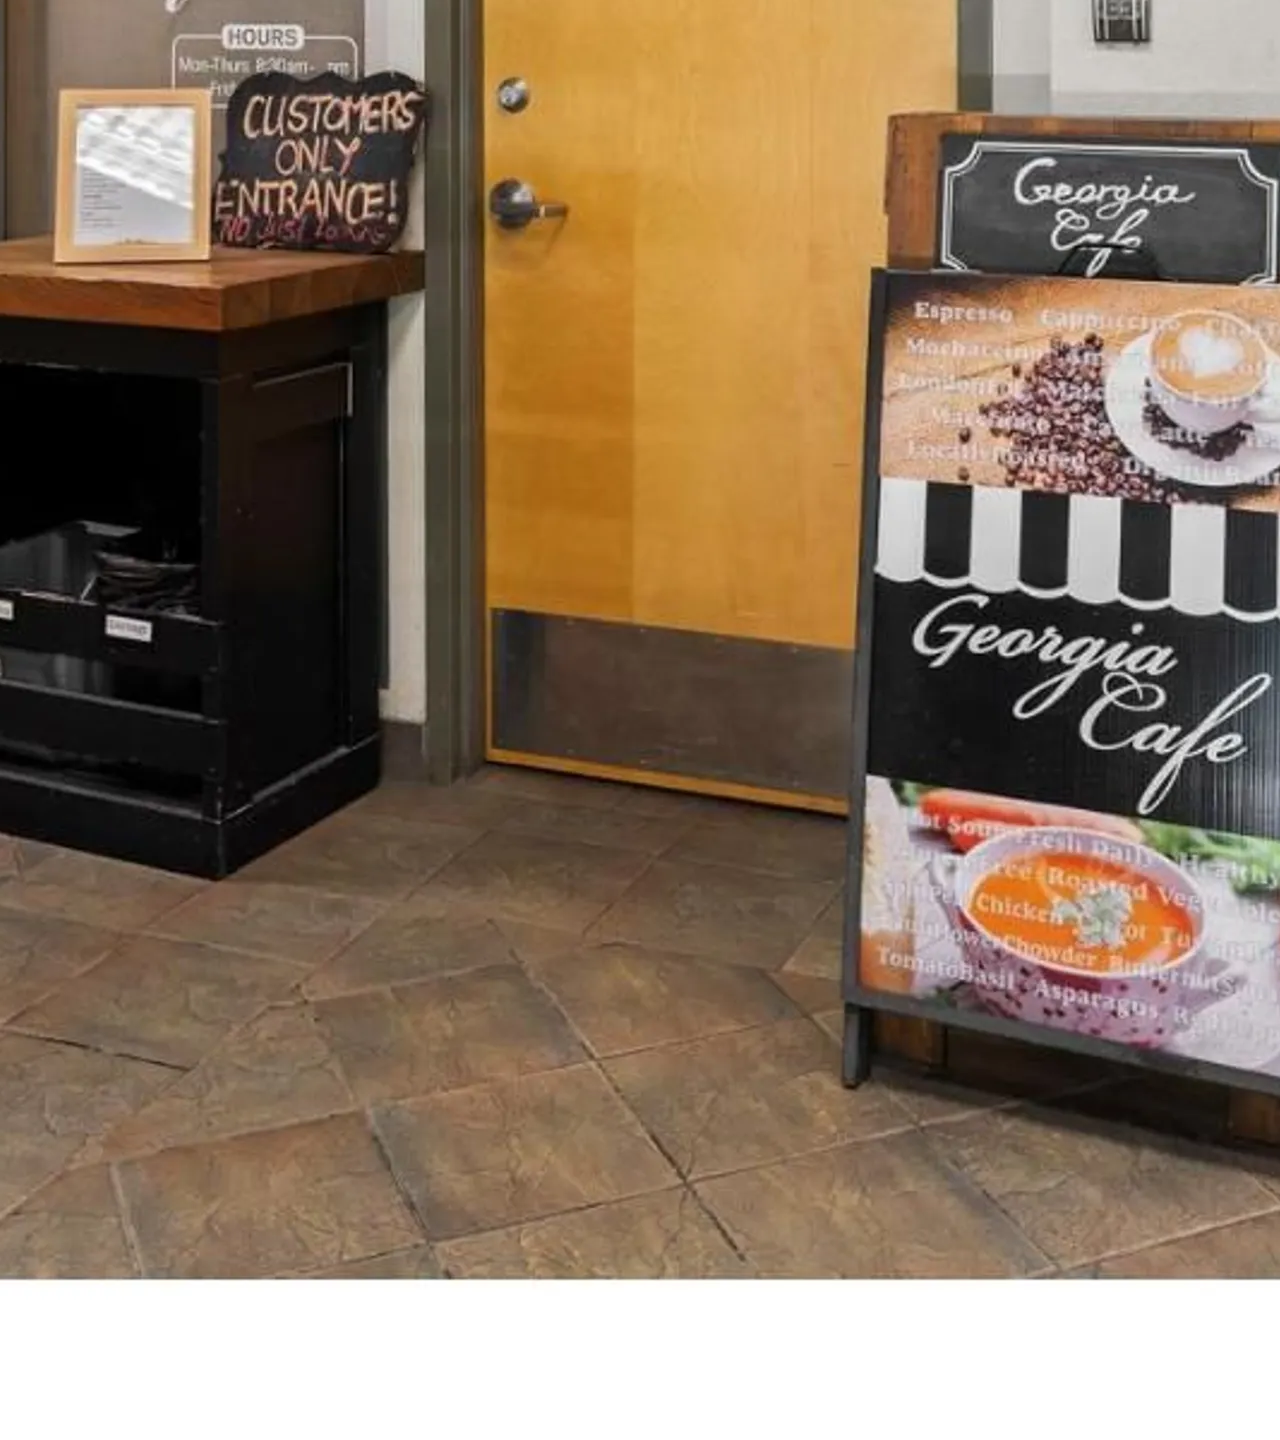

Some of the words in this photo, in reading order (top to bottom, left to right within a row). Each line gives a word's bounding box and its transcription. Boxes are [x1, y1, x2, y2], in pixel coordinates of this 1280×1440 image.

[227, 26, 299, 49] HOURS
[244, 90, 420, 139] CUSTOMERS
[275, 135, 362, 176] ONLY
[215, 177, 399, 225] ENTRANCE!
[1014, 157, 1196, 219] Georgia
[1051, 208, 1149, 277] Cafe
[915, 301, 1012, 324] Espresso
[913, 594, 1178, 719] Georgia
[1079, 672, 1272, 816] Cafe
[976, 890, 1064, 925] Chicken
[1035, 977, 1160, 1021] Asparagus
